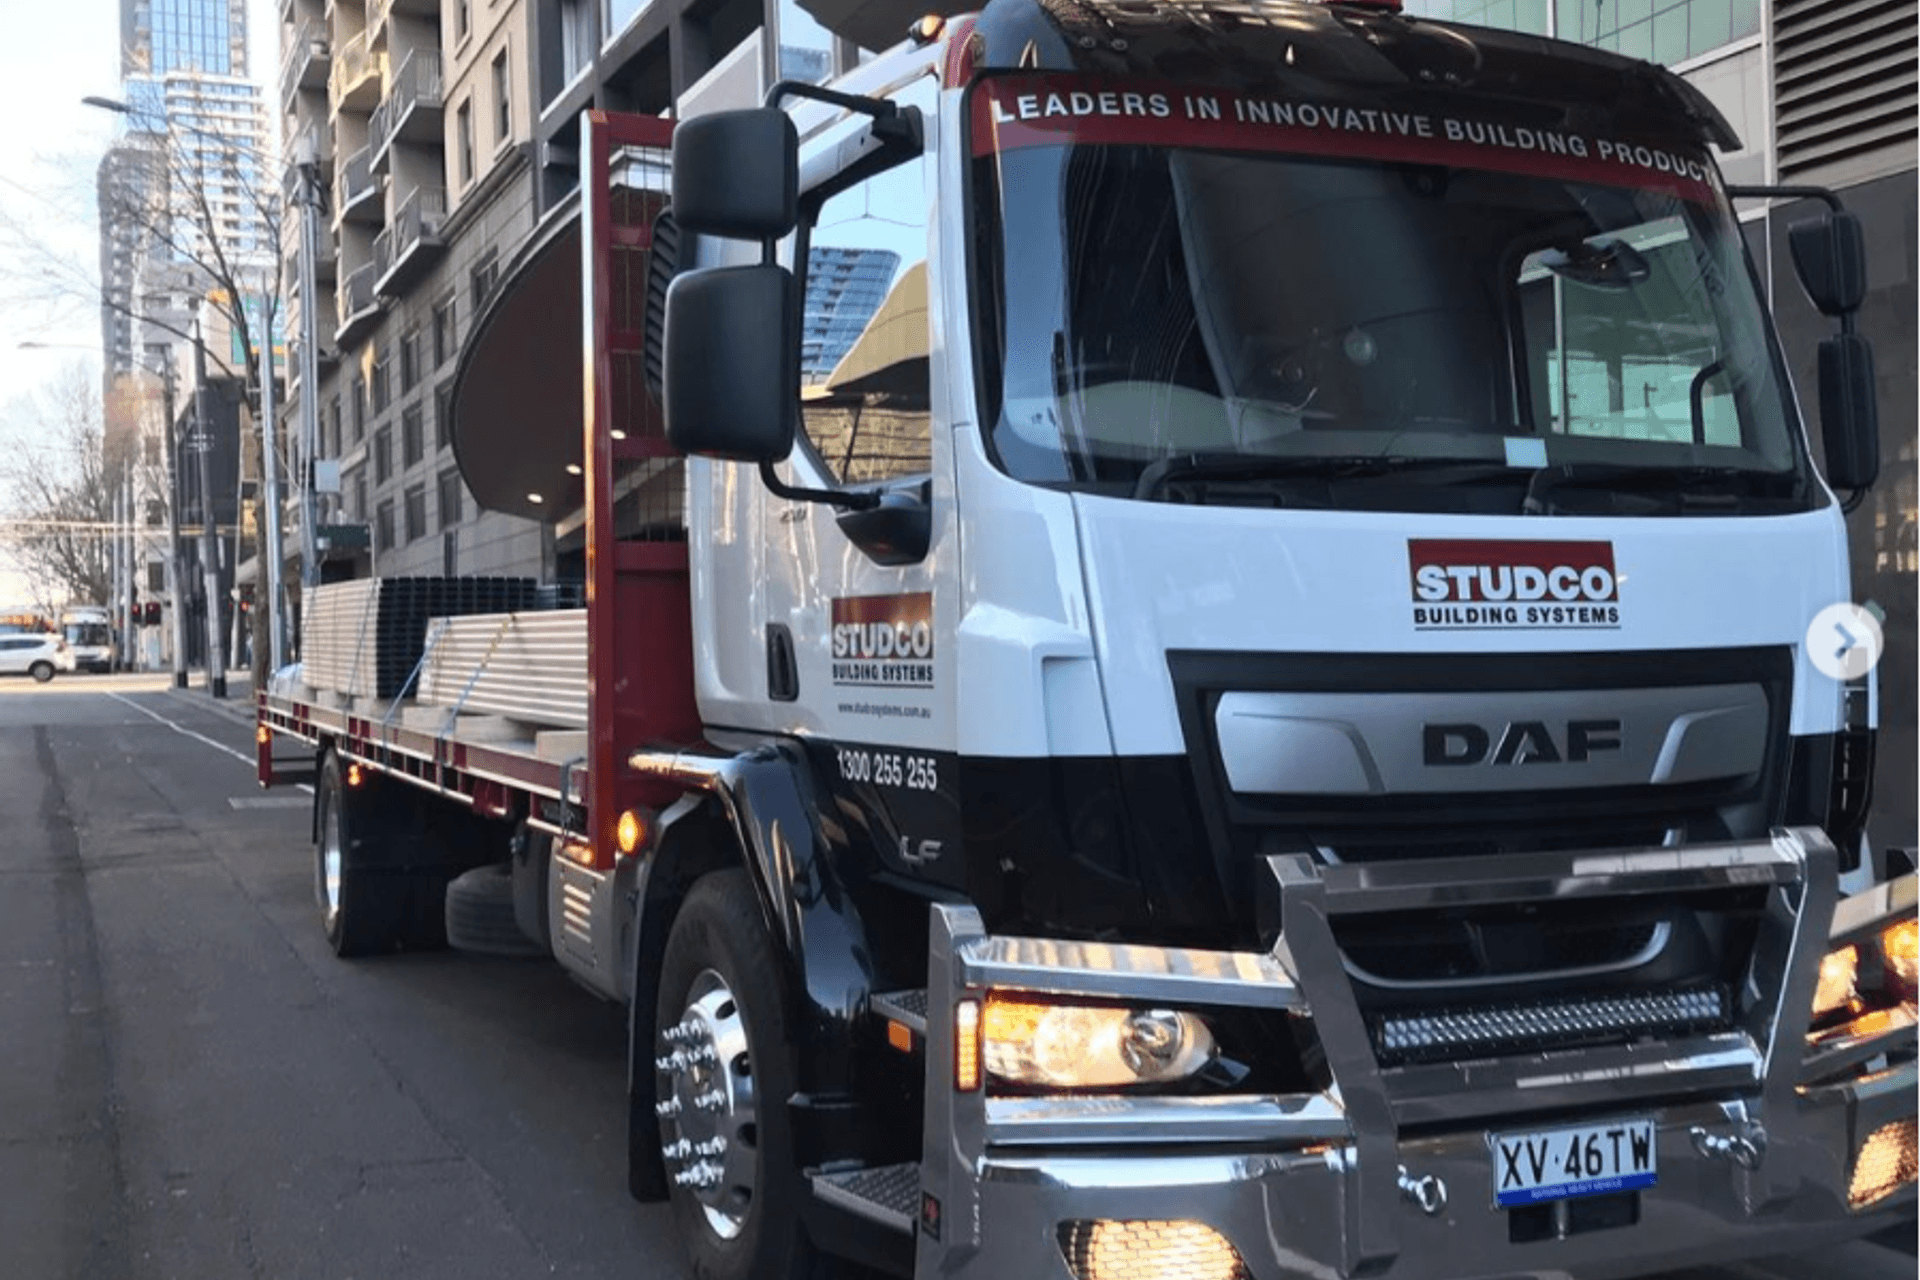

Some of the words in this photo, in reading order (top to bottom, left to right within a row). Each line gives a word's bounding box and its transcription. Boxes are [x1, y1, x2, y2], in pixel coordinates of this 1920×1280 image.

[991, 91, 1170, 123] LEADERS
[1185, 95, 1221, 120] IN
[1235, 99, 1434, 138] INNOVATIVE
[1445, 118, 1589, 157] BUILDING
[1416, 564, 1614, 601] STUDCO
[1414, 607, 1518, 624] BUILDING
[1527, 607, 1619, 624] SYSTEMS
[834, 620, 931, 658] STUDCO
[833, 664, 879, 680] BUILDING
[882, 665, 933, 682] SYSTEMS
[1422, 719, 1621, 766] DAF
[838, 749, 870, 783] 1300
[874, 752, 902, 786] 255
[907, 755, 937, 791] 255
[900, 834, 942, 866] LF
